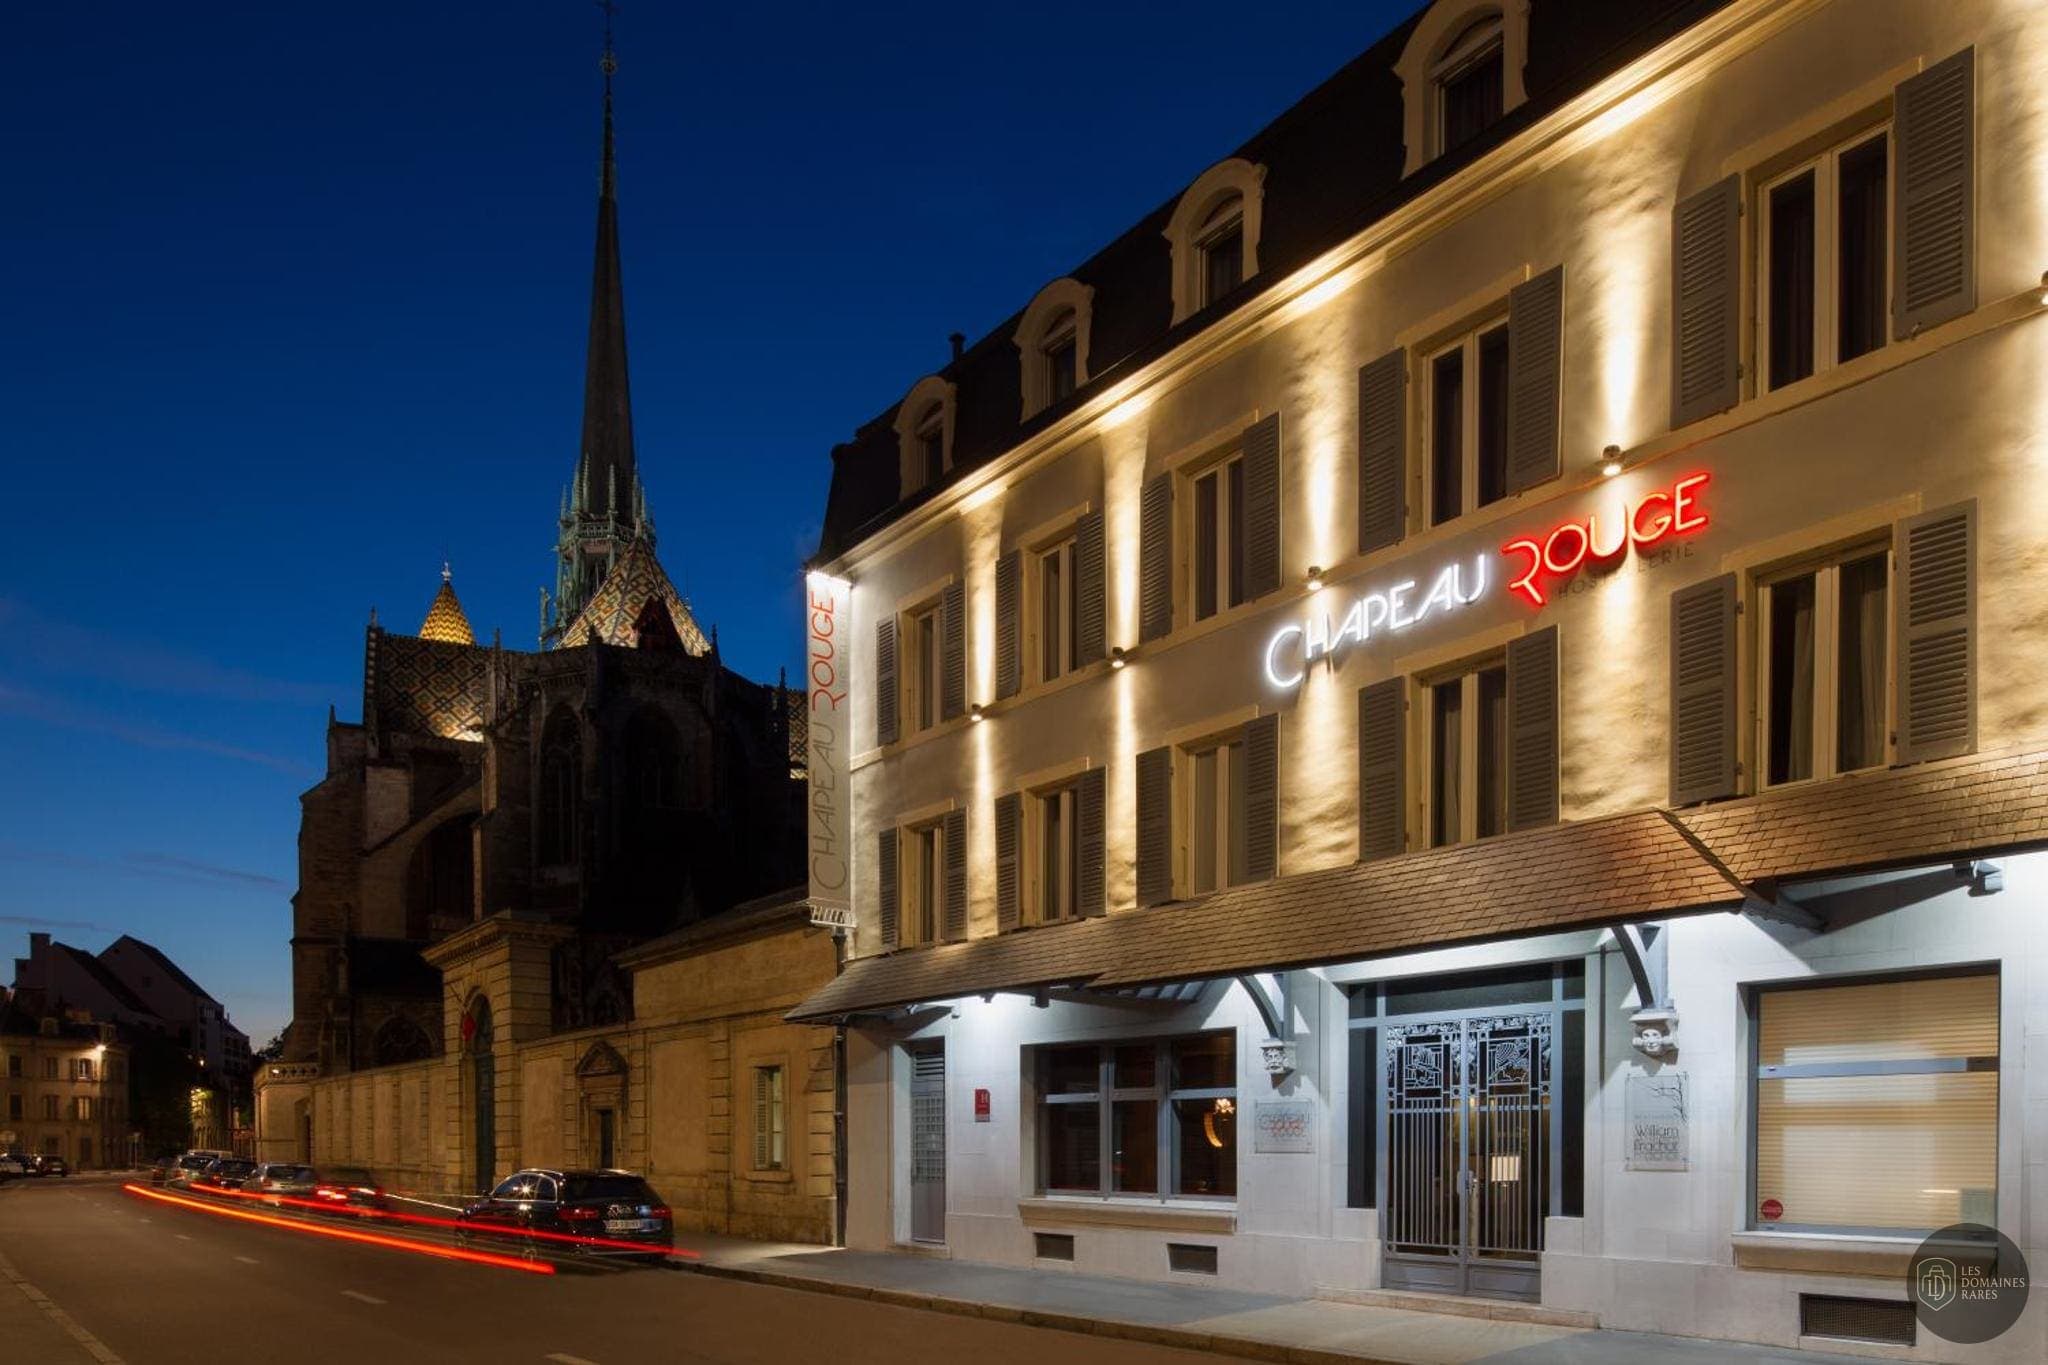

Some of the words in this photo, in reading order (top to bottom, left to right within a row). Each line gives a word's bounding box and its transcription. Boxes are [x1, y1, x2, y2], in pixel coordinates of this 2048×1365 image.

[810, 591, 847, 711] ROUGE
[1265, 553, 1487, 688] CHAPEAU
[1506, 473, 1709, 605] ROUGE
[812, 722, 848, 891] CHAPEAU
